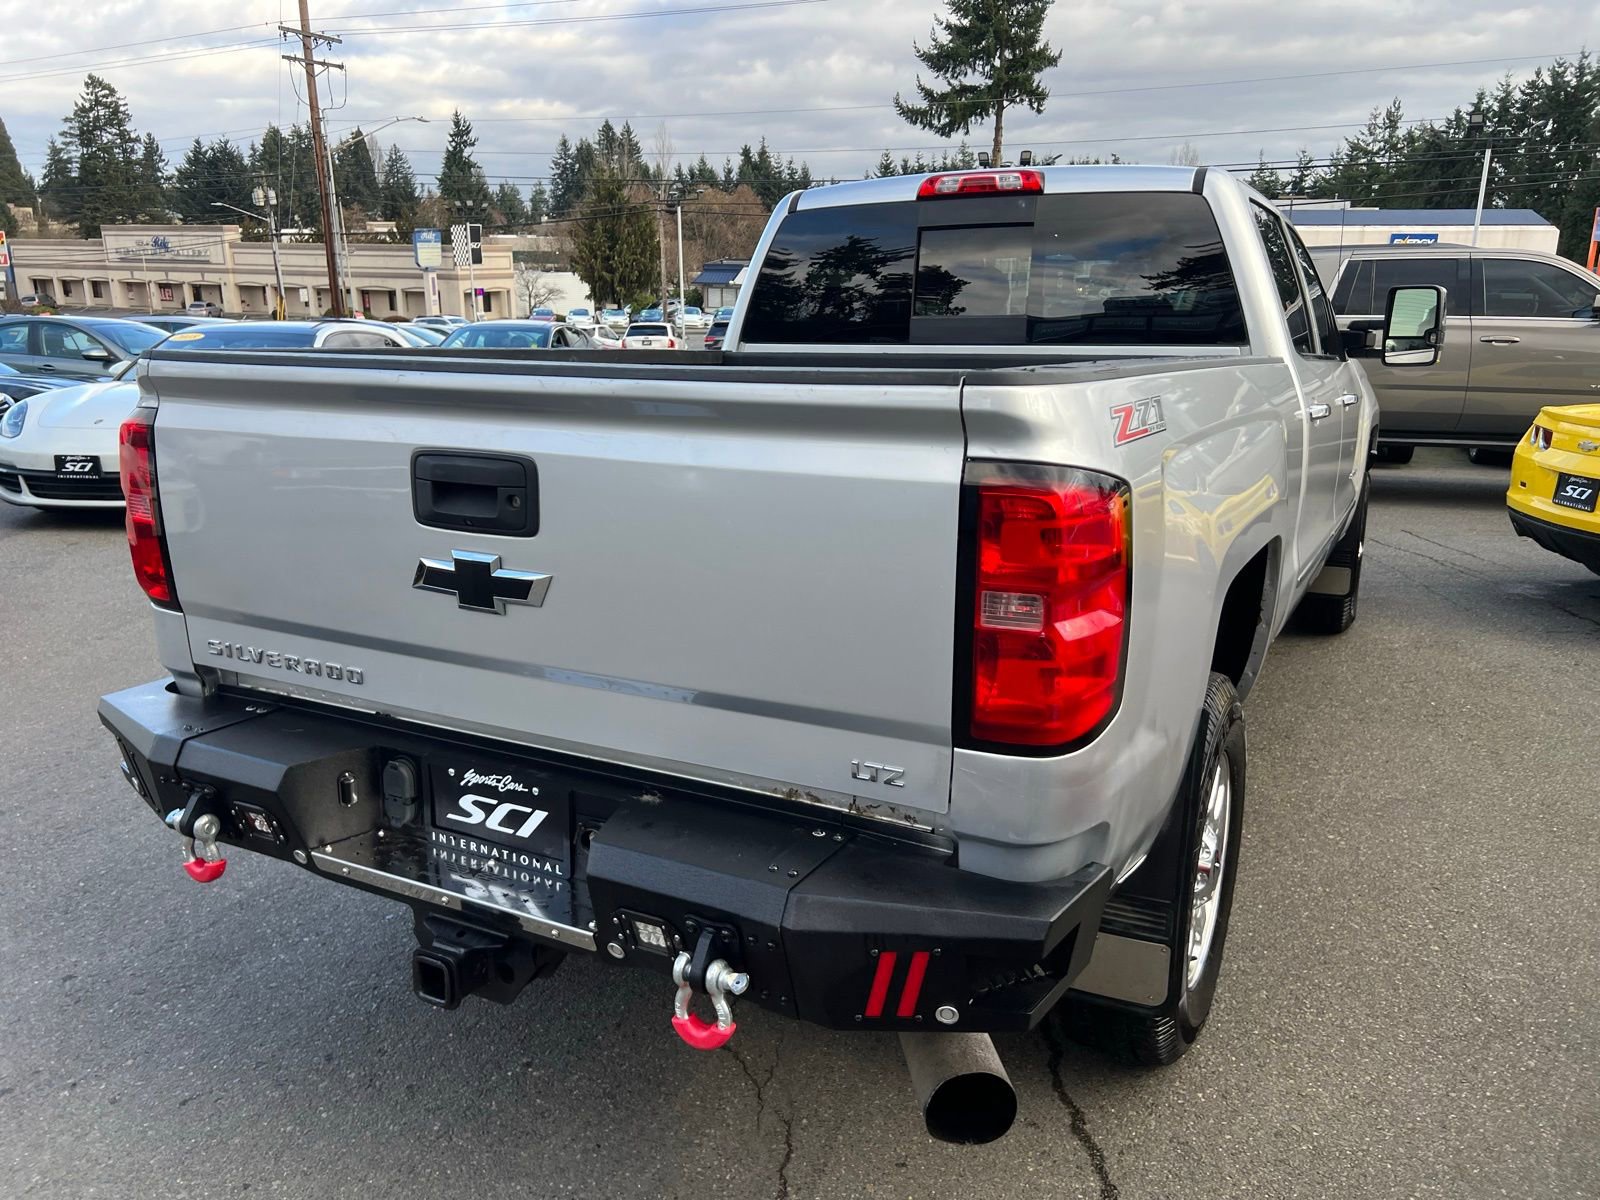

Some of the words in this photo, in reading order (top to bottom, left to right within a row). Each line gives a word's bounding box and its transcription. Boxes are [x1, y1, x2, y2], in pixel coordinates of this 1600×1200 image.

[1109, 395, 1165, 448] Z71
[61, 462, 93, 472] SCI
[1560, 485, 1592, 499] SCI
[207, 639, 364, 685] SILVERADO
[851, 760, 905, 788] LTZ
[446, 793, 549, 838] SCI
[432, 831, 563, 875] INTERNATIONAL
